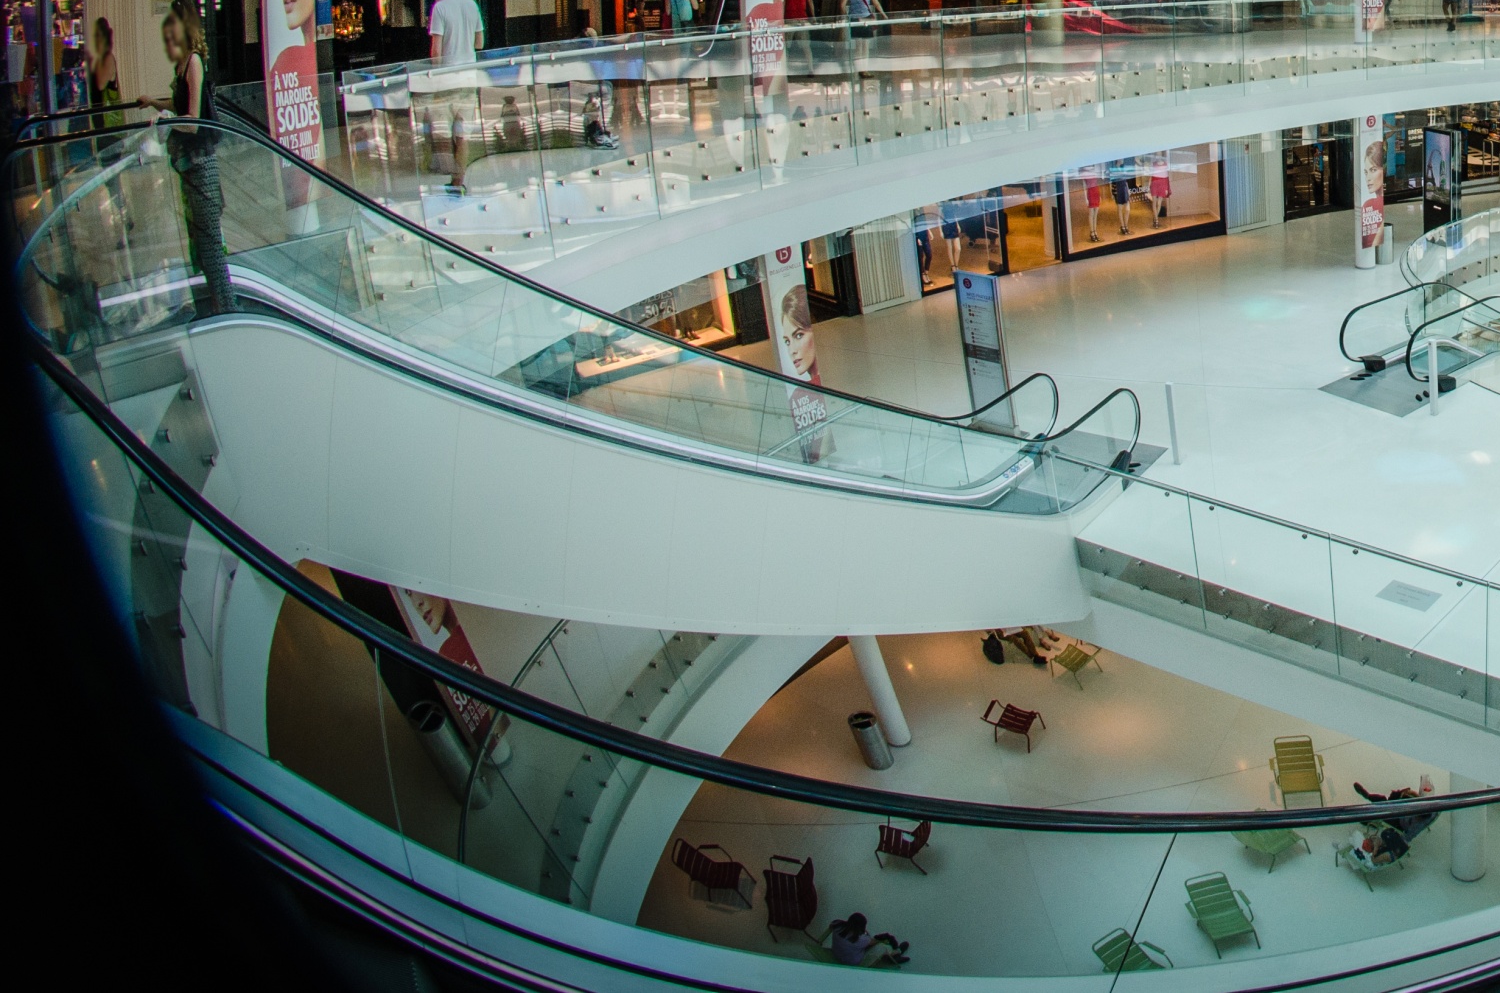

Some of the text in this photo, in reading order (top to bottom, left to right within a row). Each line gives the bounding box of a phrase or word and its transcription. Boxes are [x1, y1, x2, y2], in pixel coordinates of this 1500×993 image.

[755, 18, 768, 28] VOS
[752, 35, 784, 53] SOLDES
[274, 71, 298, 90] À VOS
[277, 100, 320, 133] SOLDES
[290, 133, 299, 150] 25
[300, 130, 313, 147] JUIN
[1362, 214, 1382, 226] SOLDES
[797, 395, 809, 406] VOS
[795, 404, 827, 429] SOLDES
